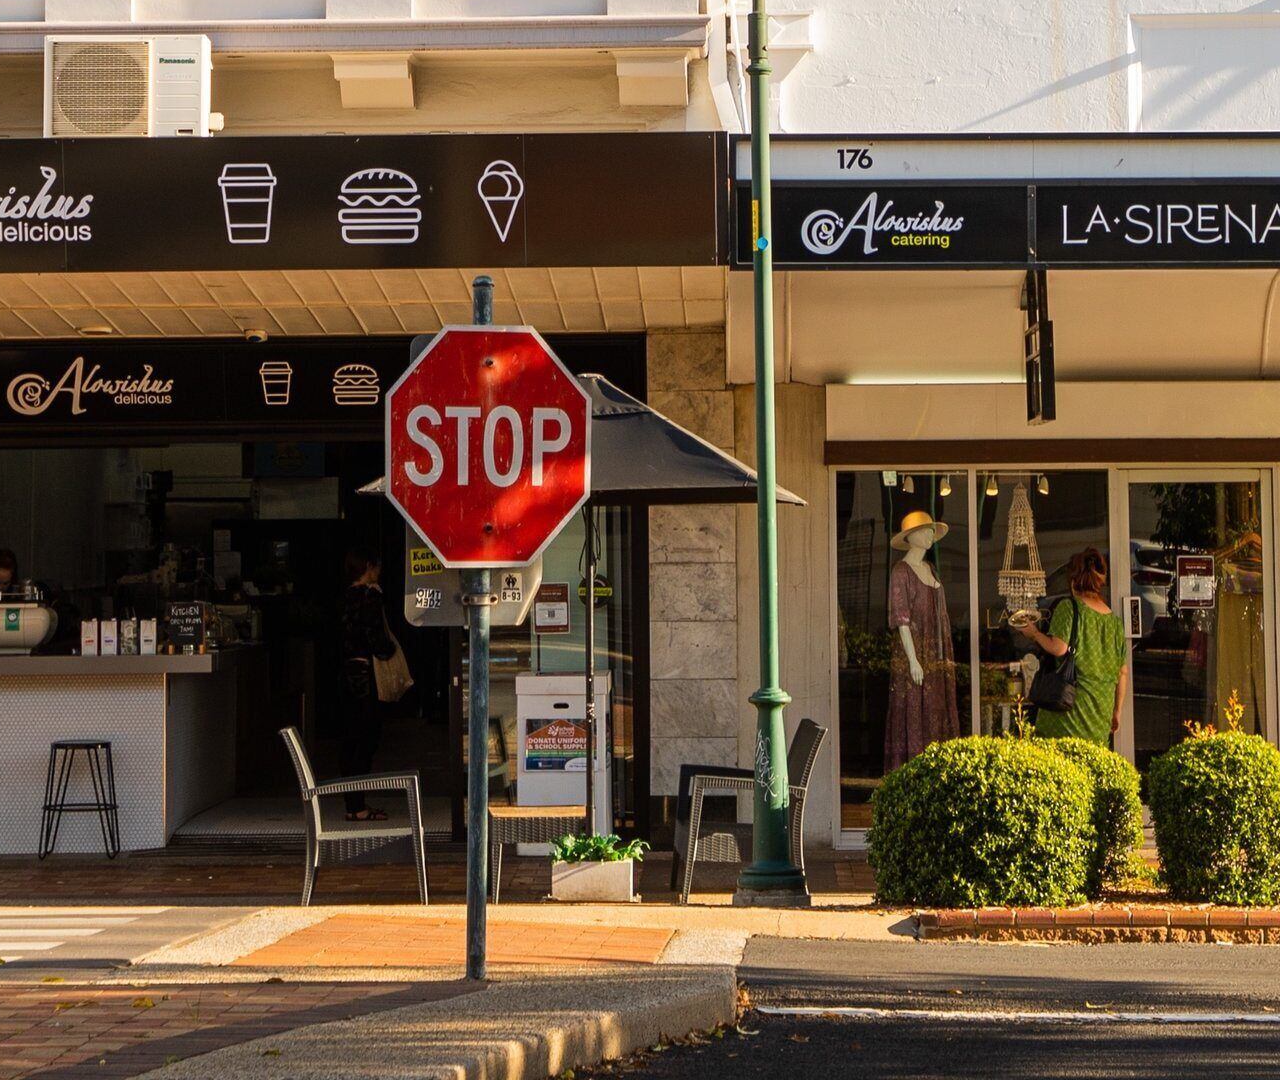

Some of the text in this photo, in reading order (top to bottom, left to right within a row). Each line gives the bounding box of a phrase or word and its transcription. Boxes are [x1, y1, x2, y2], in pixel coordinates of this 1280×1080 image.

[837, 149, 873, 169] 176
[801, 191, 964, 255] Alowishus
[891, 233, 950, 248] catering
[6, 356, 174, 415] Alowishus
[114, 393, 172, 404] delicious
[404, 405, 572, 488] STOP
[502, 591, 520, 601] 8-93
[171, 606, 199, 615] KITCHEN
[1131, 600, 1139, 635] PUSH
